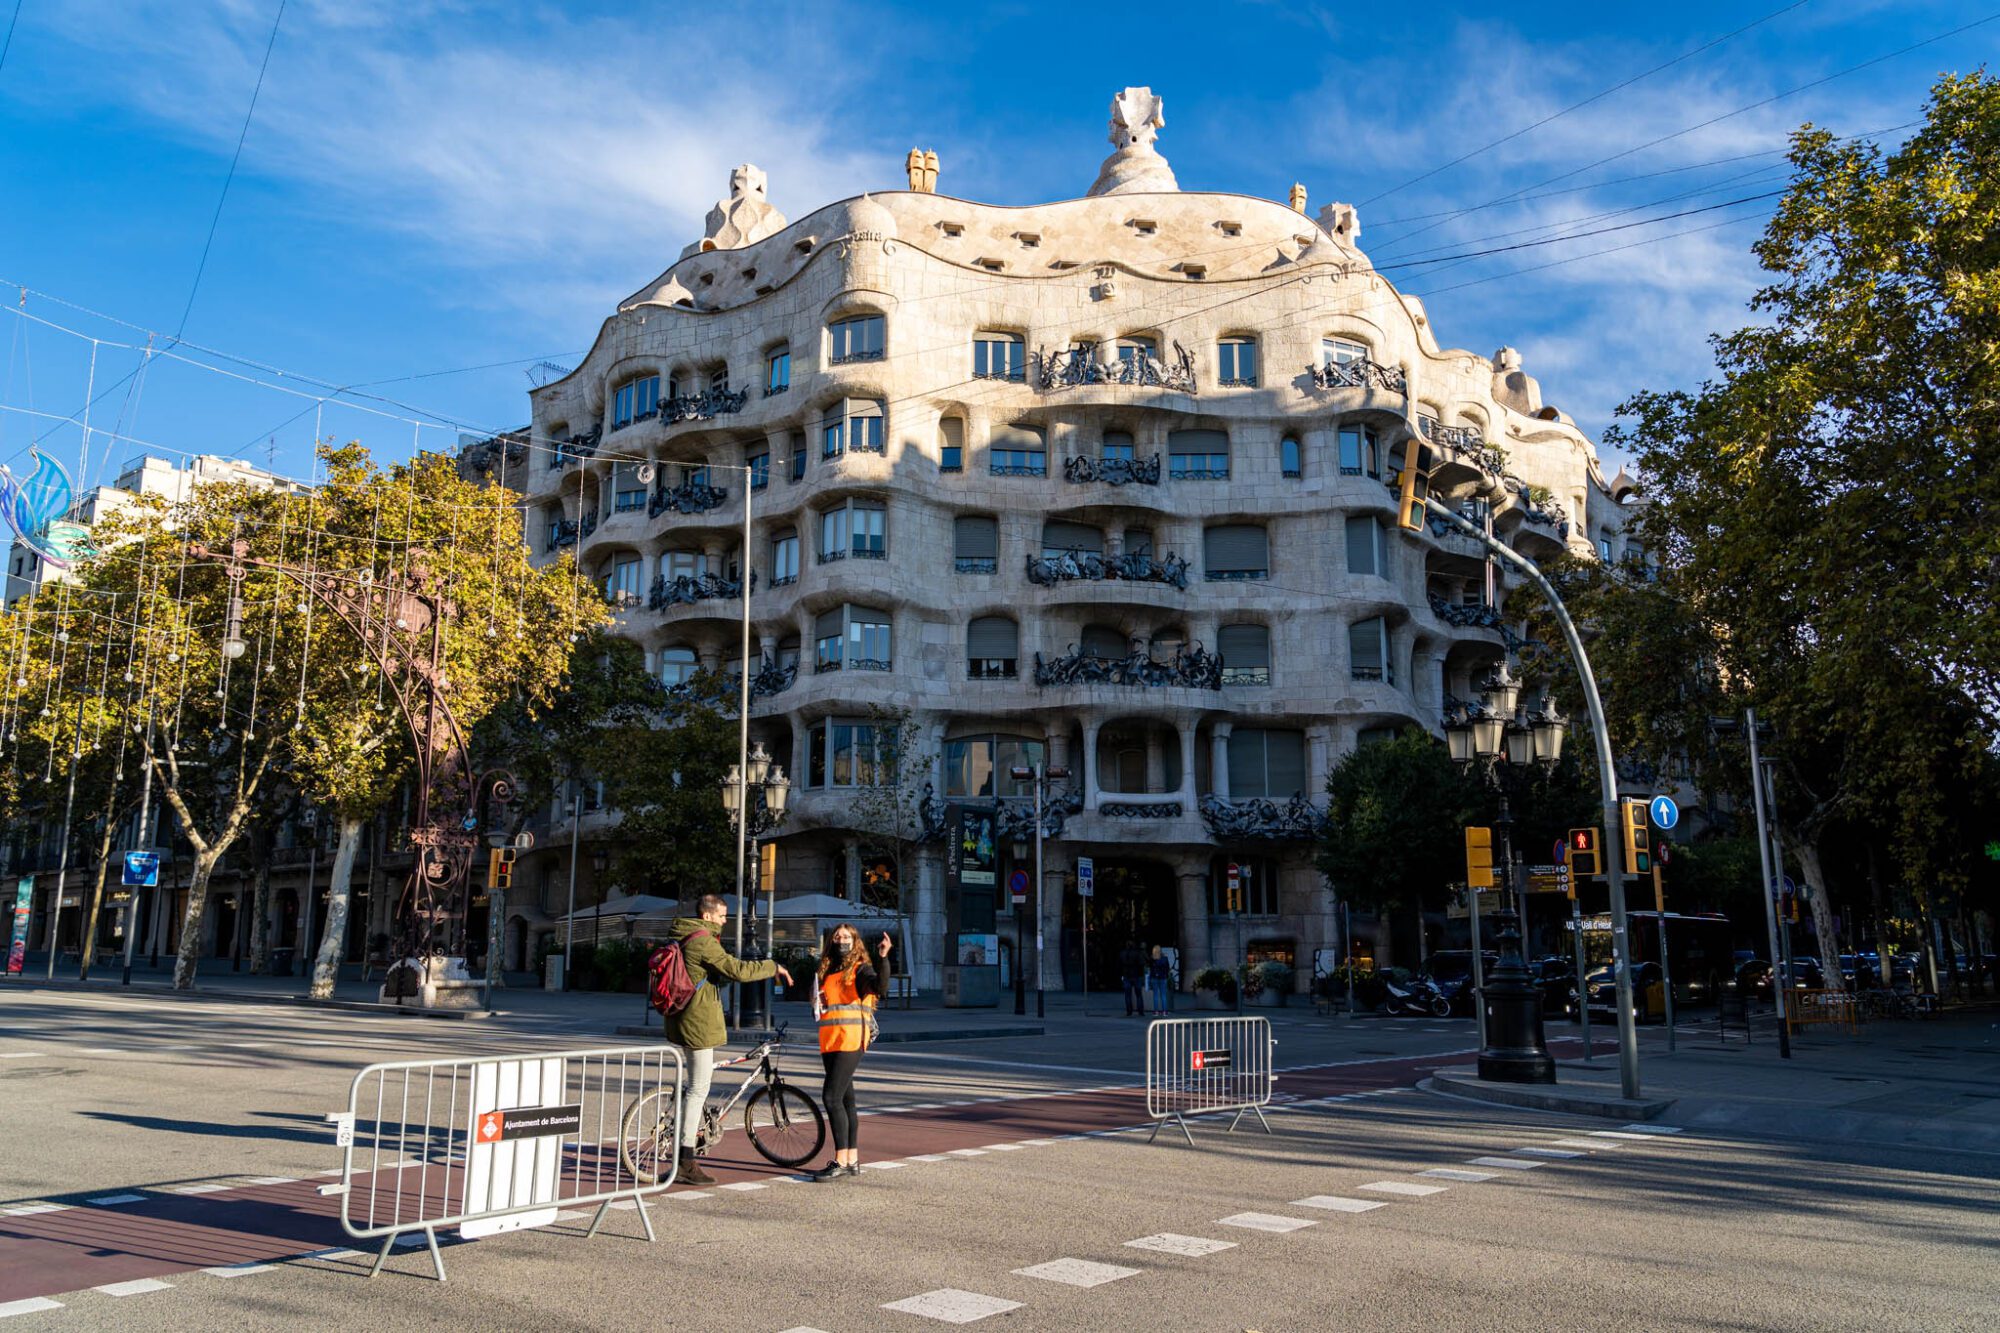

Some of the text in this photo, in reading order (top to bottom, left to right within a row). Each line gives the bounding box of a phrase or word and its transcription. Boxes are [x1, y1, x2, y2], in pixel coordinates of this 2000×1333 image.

[504, 1115, 579, 1130] Ajuntament de Barcelona
